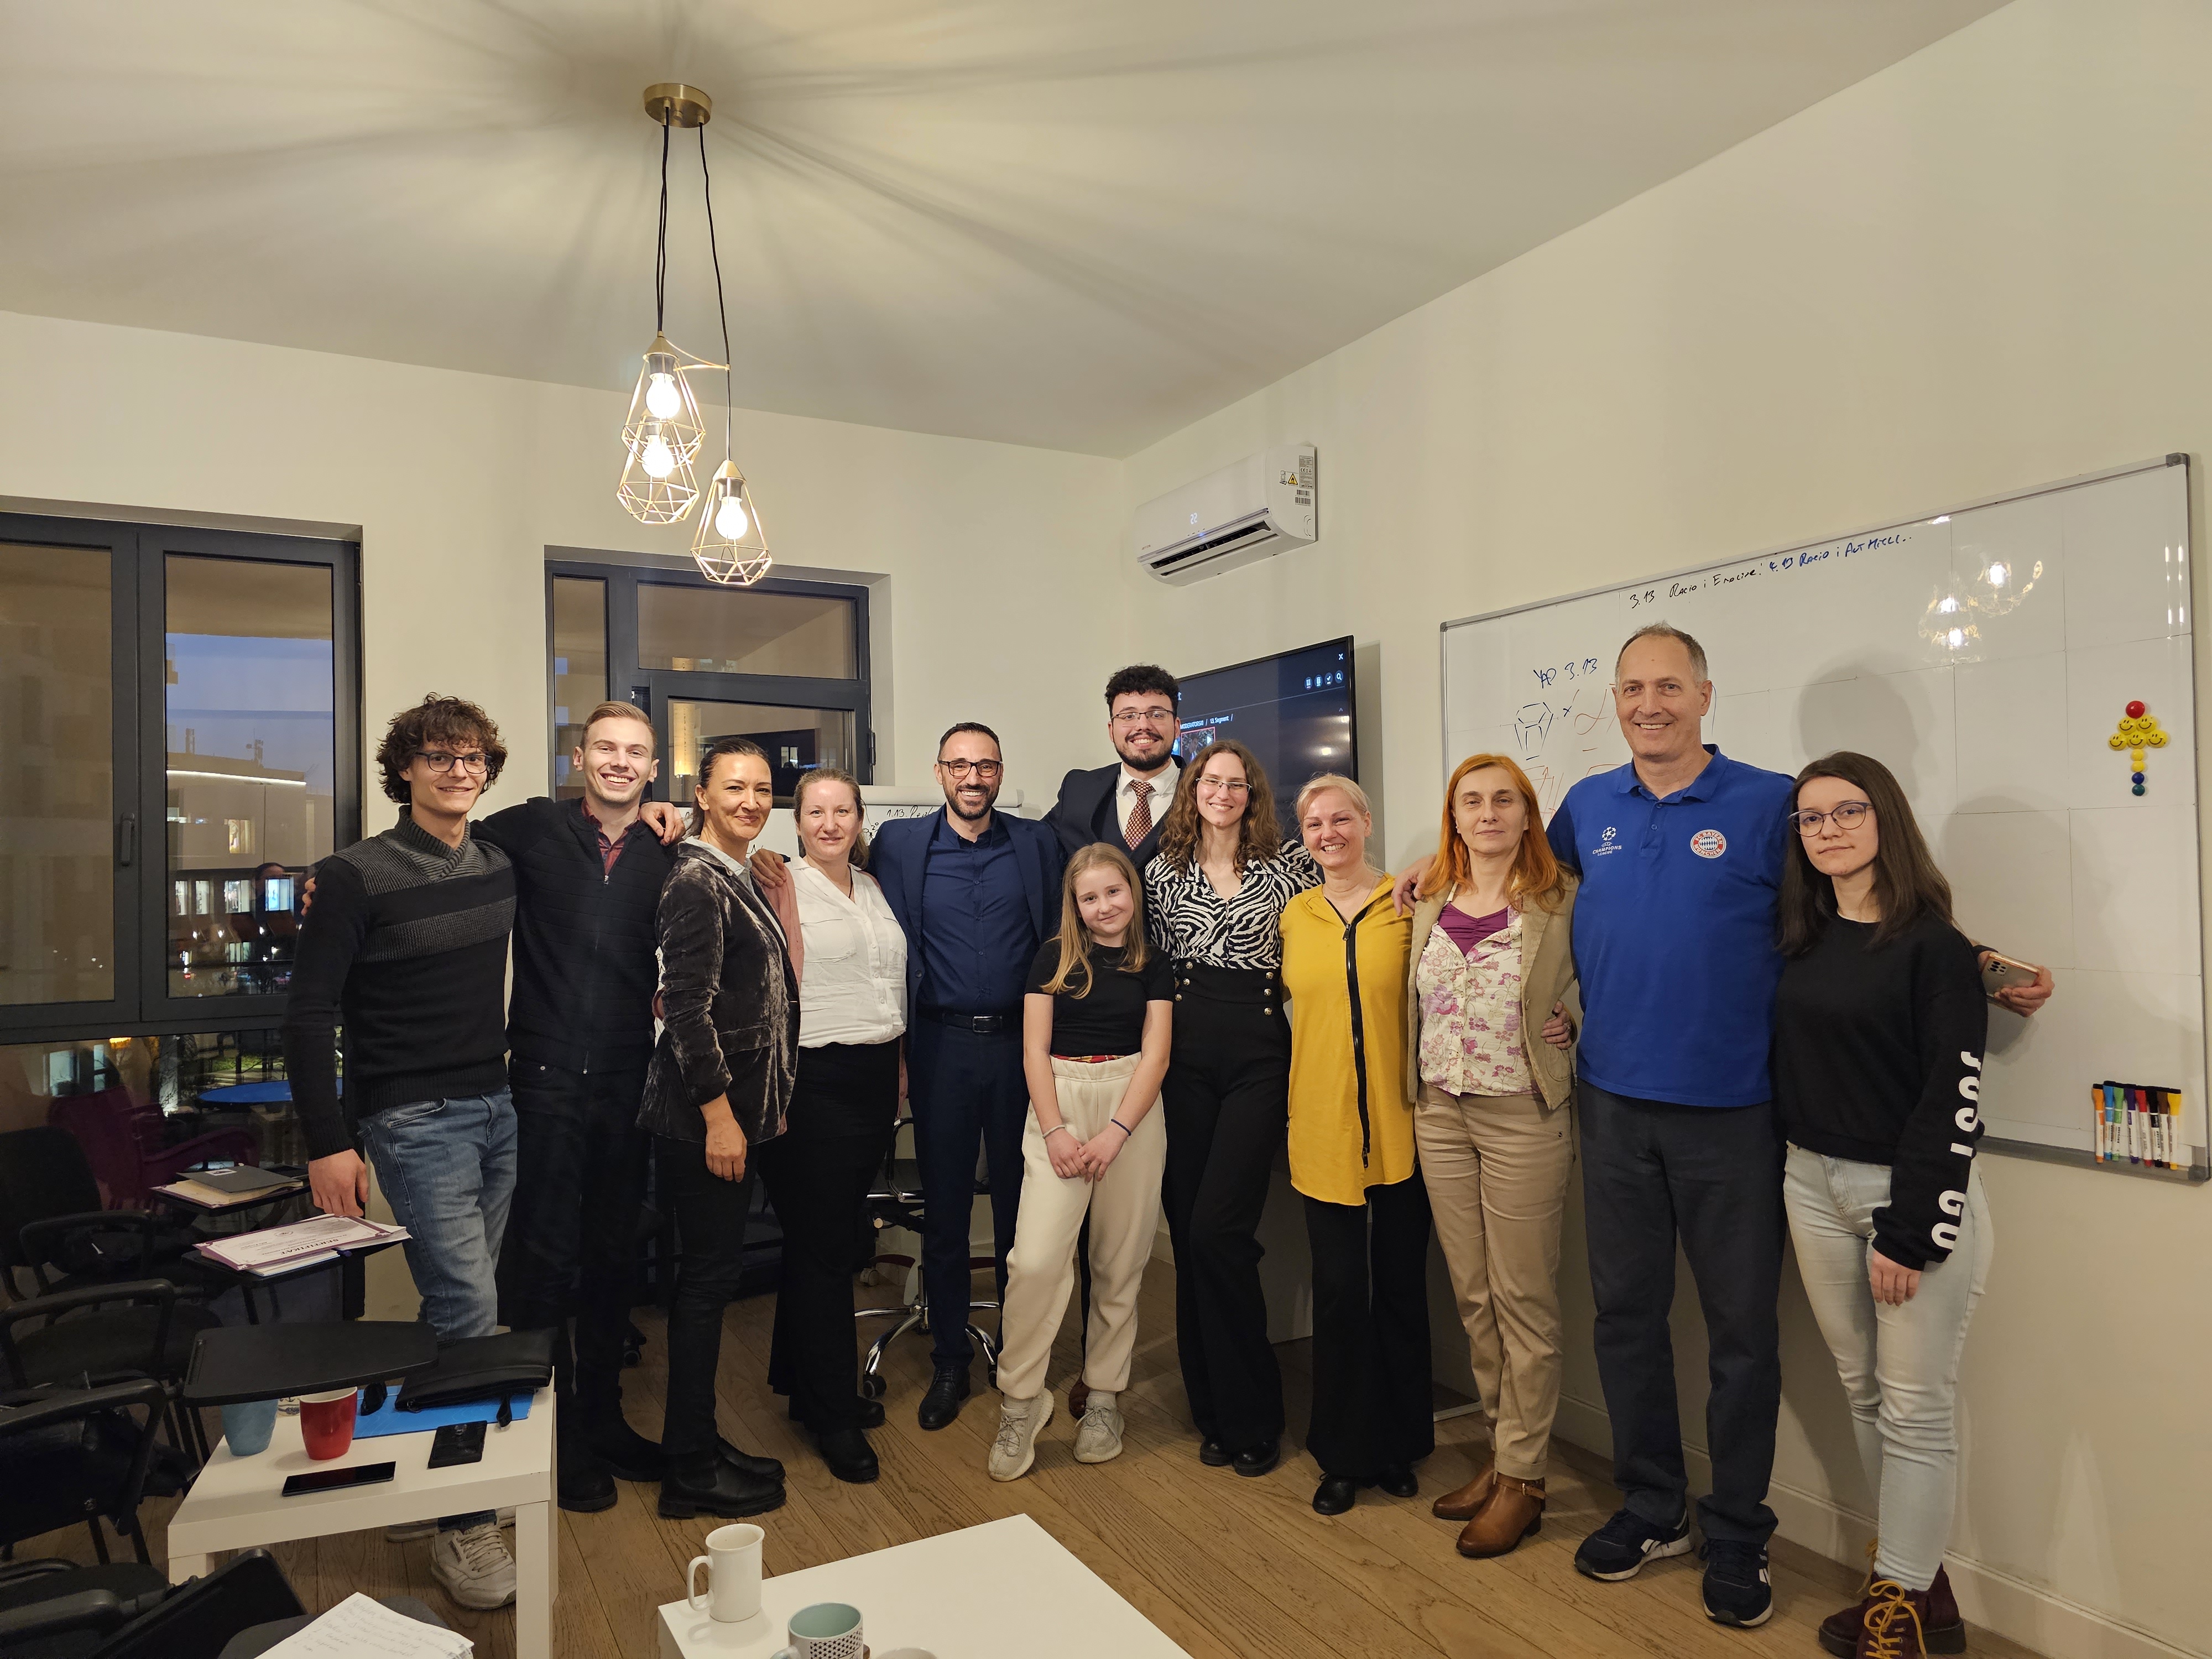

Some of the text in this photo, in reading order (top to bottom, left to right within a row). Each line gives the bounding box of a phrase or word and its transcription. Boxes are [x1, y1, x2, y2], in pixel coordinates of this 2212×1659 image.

[1190, 512, 1198, 525] 22
[1702, 831, 1723, 844] BAYERN
[1592, 845, 1622, 854] CHAMPIONS
[281, 1239, 339, 1255] SERTIFIKAT
